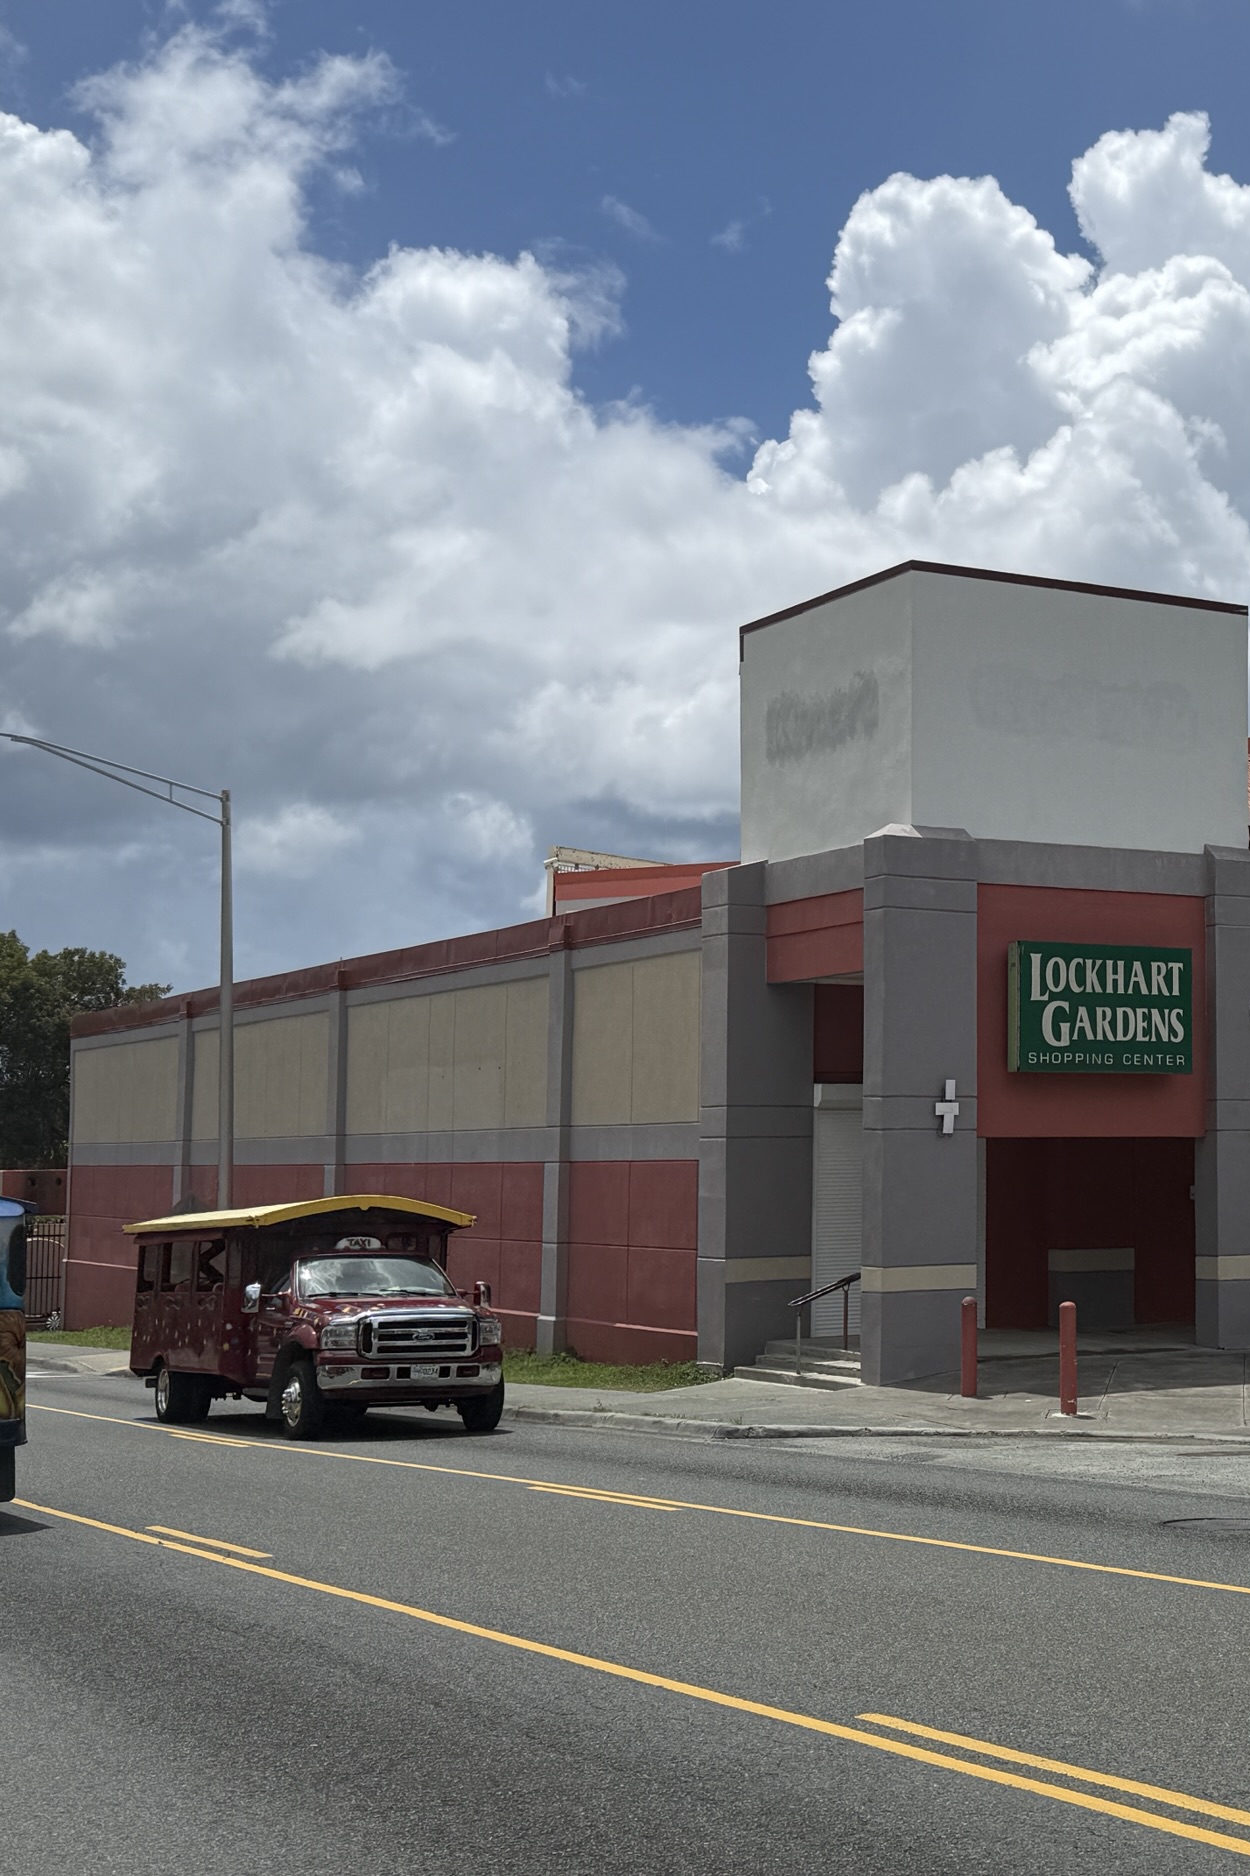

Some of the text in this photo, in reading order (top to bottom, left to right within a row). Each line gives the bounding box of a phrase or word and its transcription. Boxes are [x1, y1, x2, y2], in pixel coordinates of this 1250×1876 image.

[1030, 953, 1184, 1001] LOCKHART
[1041, 1000, 1185, 1047] GARDENS
[1028, 1052, 1186, 1066] SHOPPING CENTER
[346, 1238, 372, 1248] TAXI
